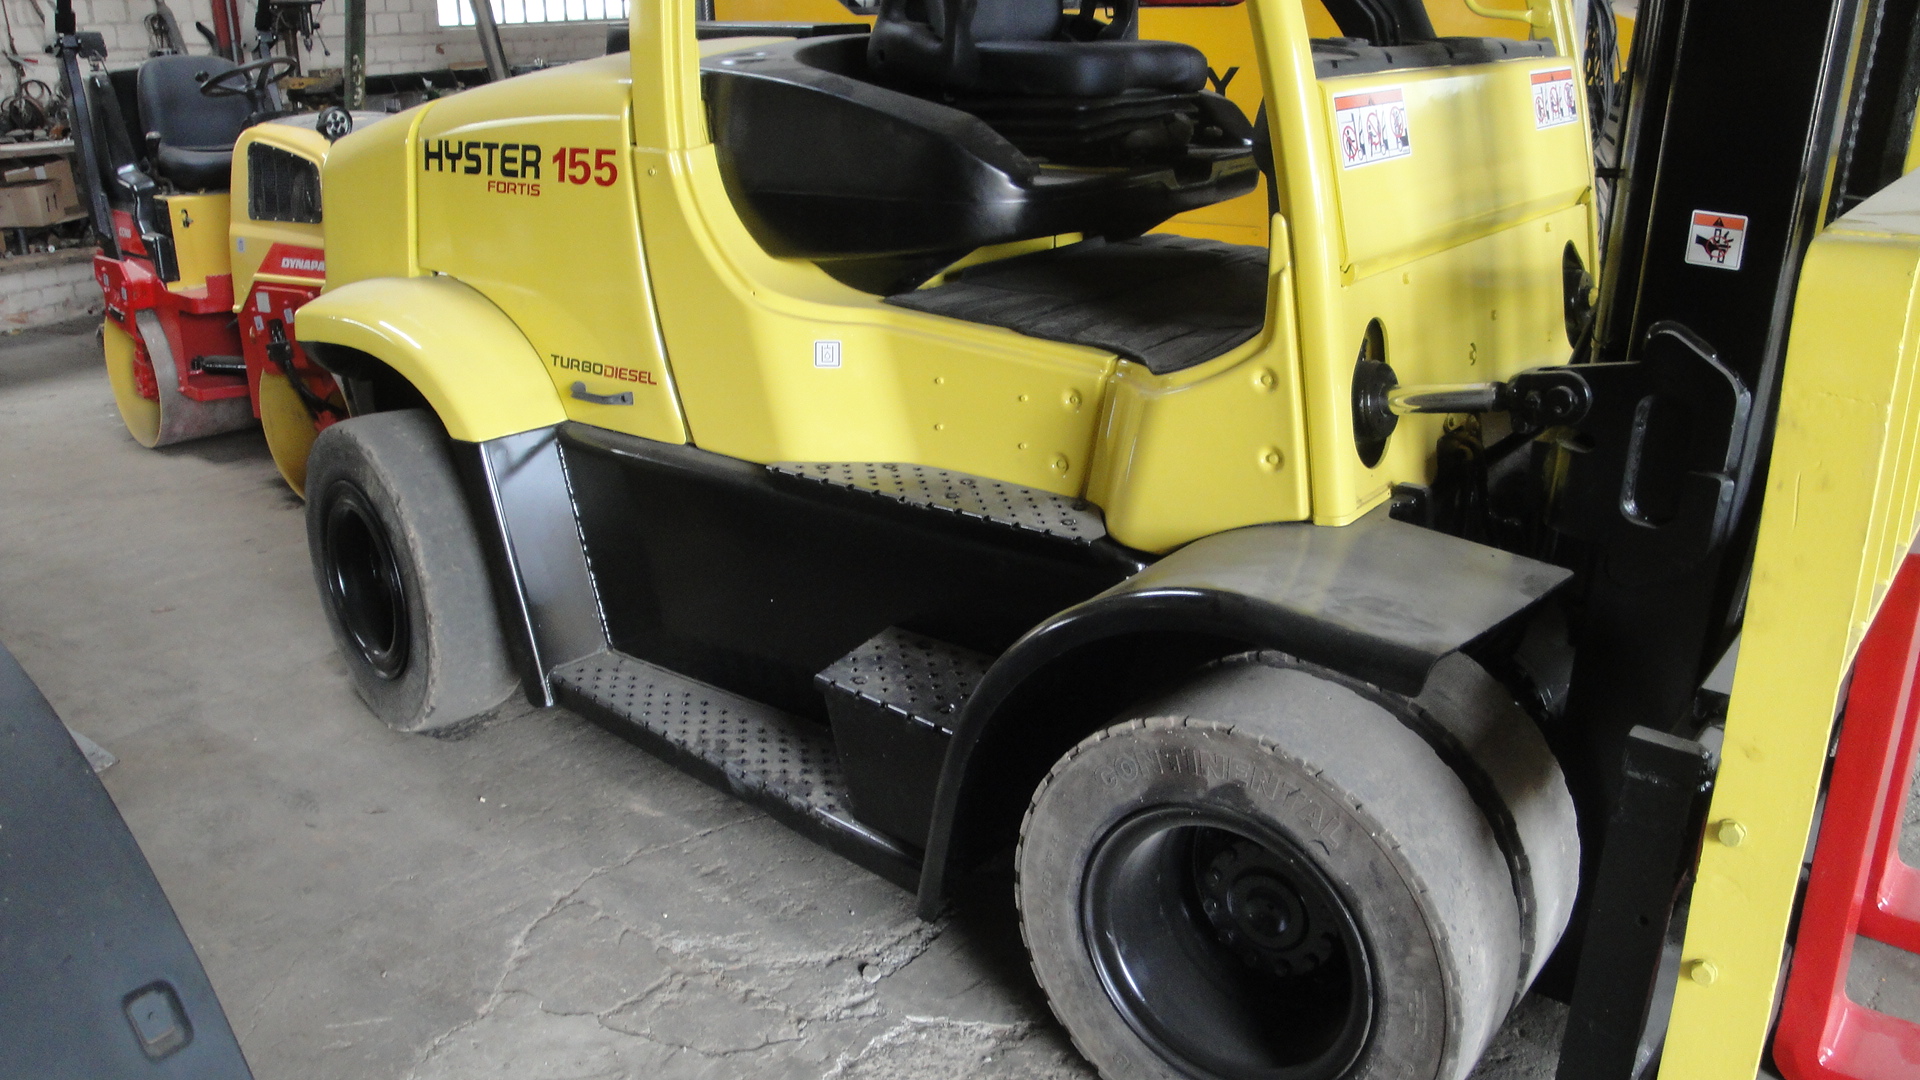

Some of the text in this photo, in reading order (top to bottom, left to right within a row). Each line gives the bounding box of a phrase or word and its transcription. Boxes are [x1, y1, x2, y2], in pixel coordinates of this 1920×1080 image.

[424, 139, 618, 187] HYSTER 155
[487, 180, 541, 197] FORTIS
[551, 354, 657, 385] TURBODIESEL
[1094, 747, 1342, 850] CONTINENTAL
